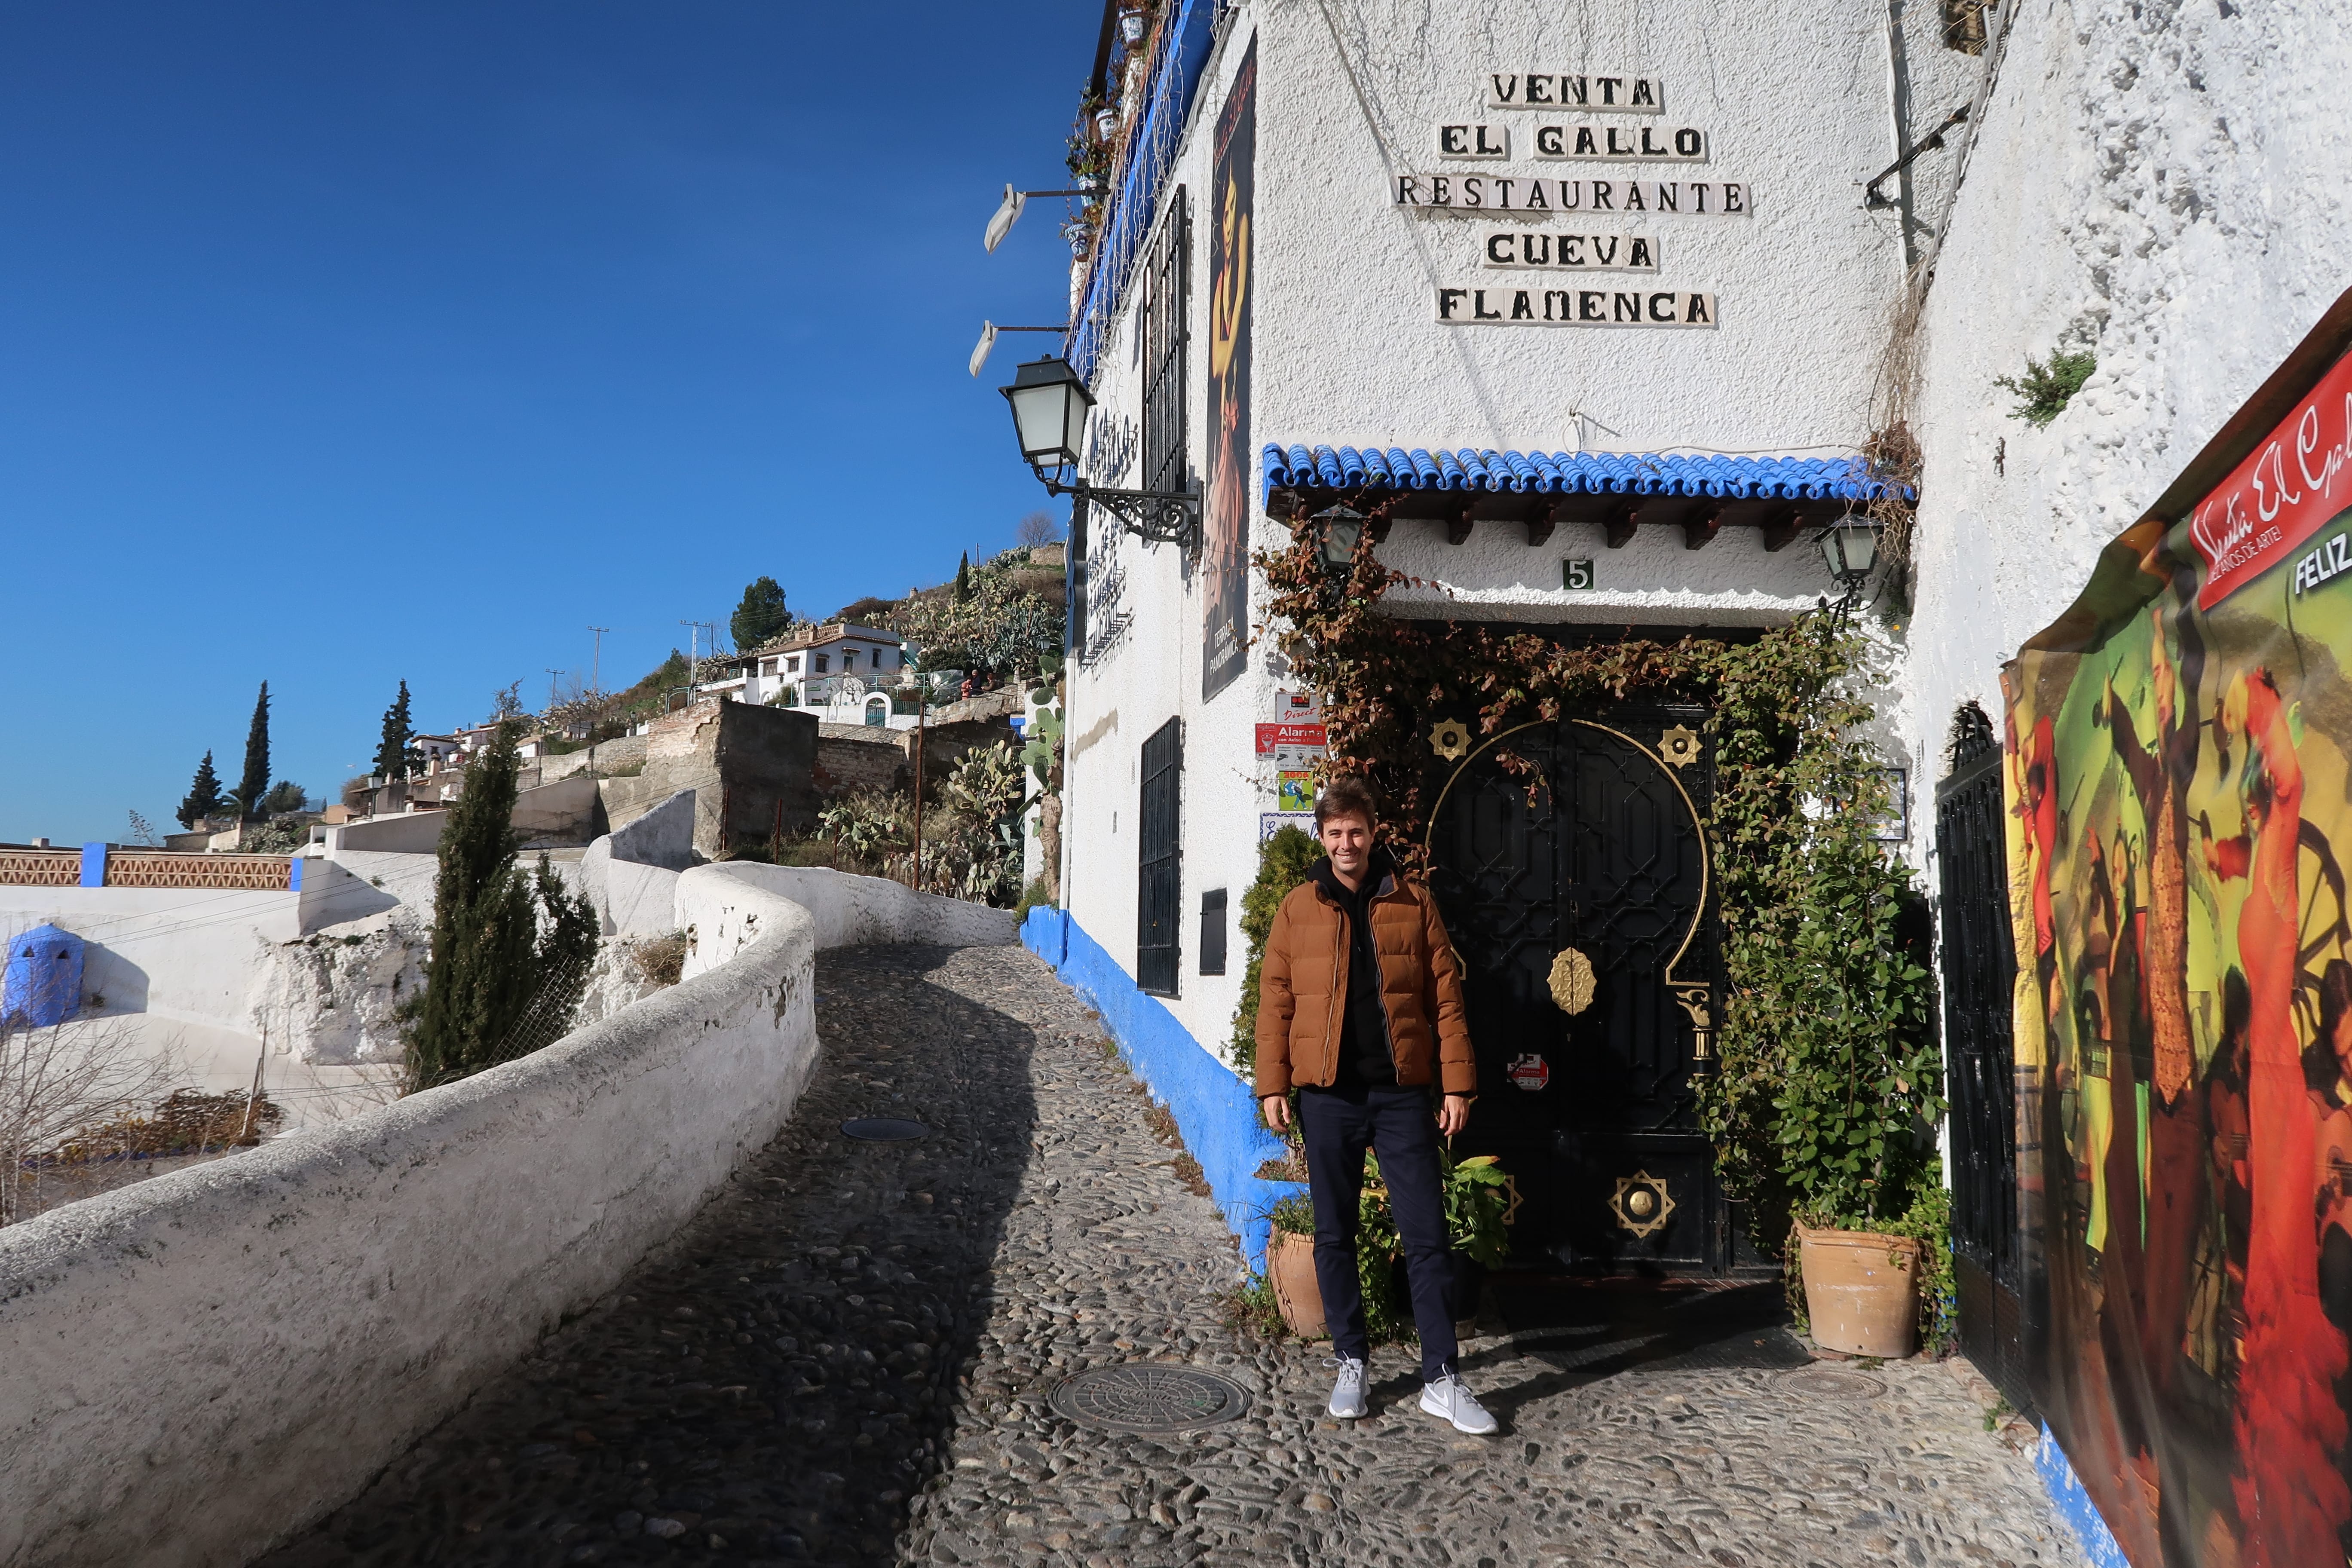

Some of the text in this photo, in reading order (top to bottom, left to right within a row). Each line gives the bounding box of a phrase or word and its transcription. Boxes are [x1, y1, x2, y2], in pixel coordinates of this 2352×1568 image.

[1490, 74, 1655, 105] VENTA
[1441, 125, 1702, 156] EL GALLO
[1397, 176, 1744, 212] RESTAURANTE
[1487, 234, 1654, 266] CUEVA
[1439, 288, 1709, 323] FLAMENCA
[2253, 441, 2300, 522] El
[2241, 542, 2258, 559] DE
[2295, 533, 2352, 594] FELIZ
[1569, 561, 1588, 588] 5
[1215, 616, 1234, 649] TERRAZA
[1210, 637, 1238, 676] PANORÁMICA
[1283, 707, 1318, 721] Direct
[1278, 727, 1323, 737] Alarma
